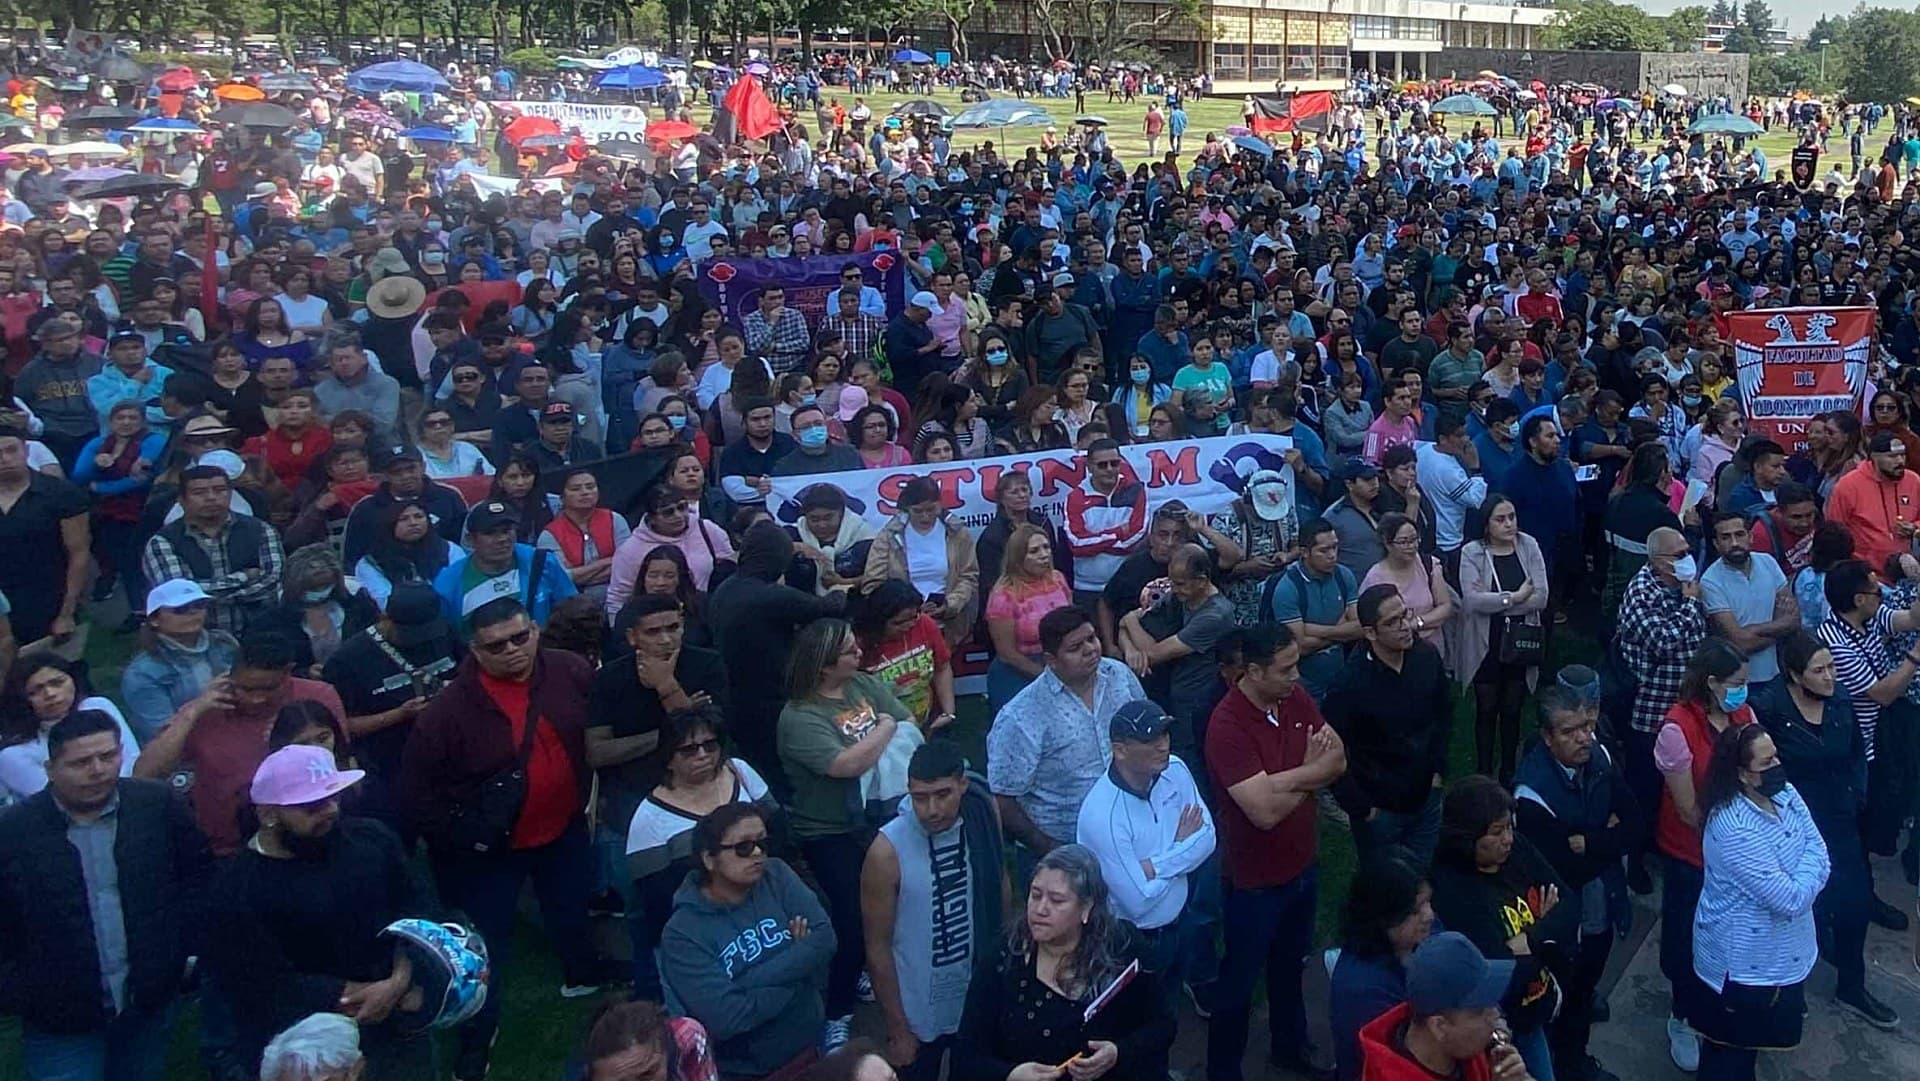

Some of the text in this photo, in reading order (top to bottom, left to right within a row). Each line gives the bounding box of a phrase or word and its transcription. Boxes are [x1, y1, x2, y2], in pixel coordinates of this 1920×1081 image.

[1765, 348, 1844, 363] FACULTAD
[1793, 371, 1815, 386] DE
[1777, 423, 1810, 434] UN
[930, 842, 970, 969] ORIGINAL
